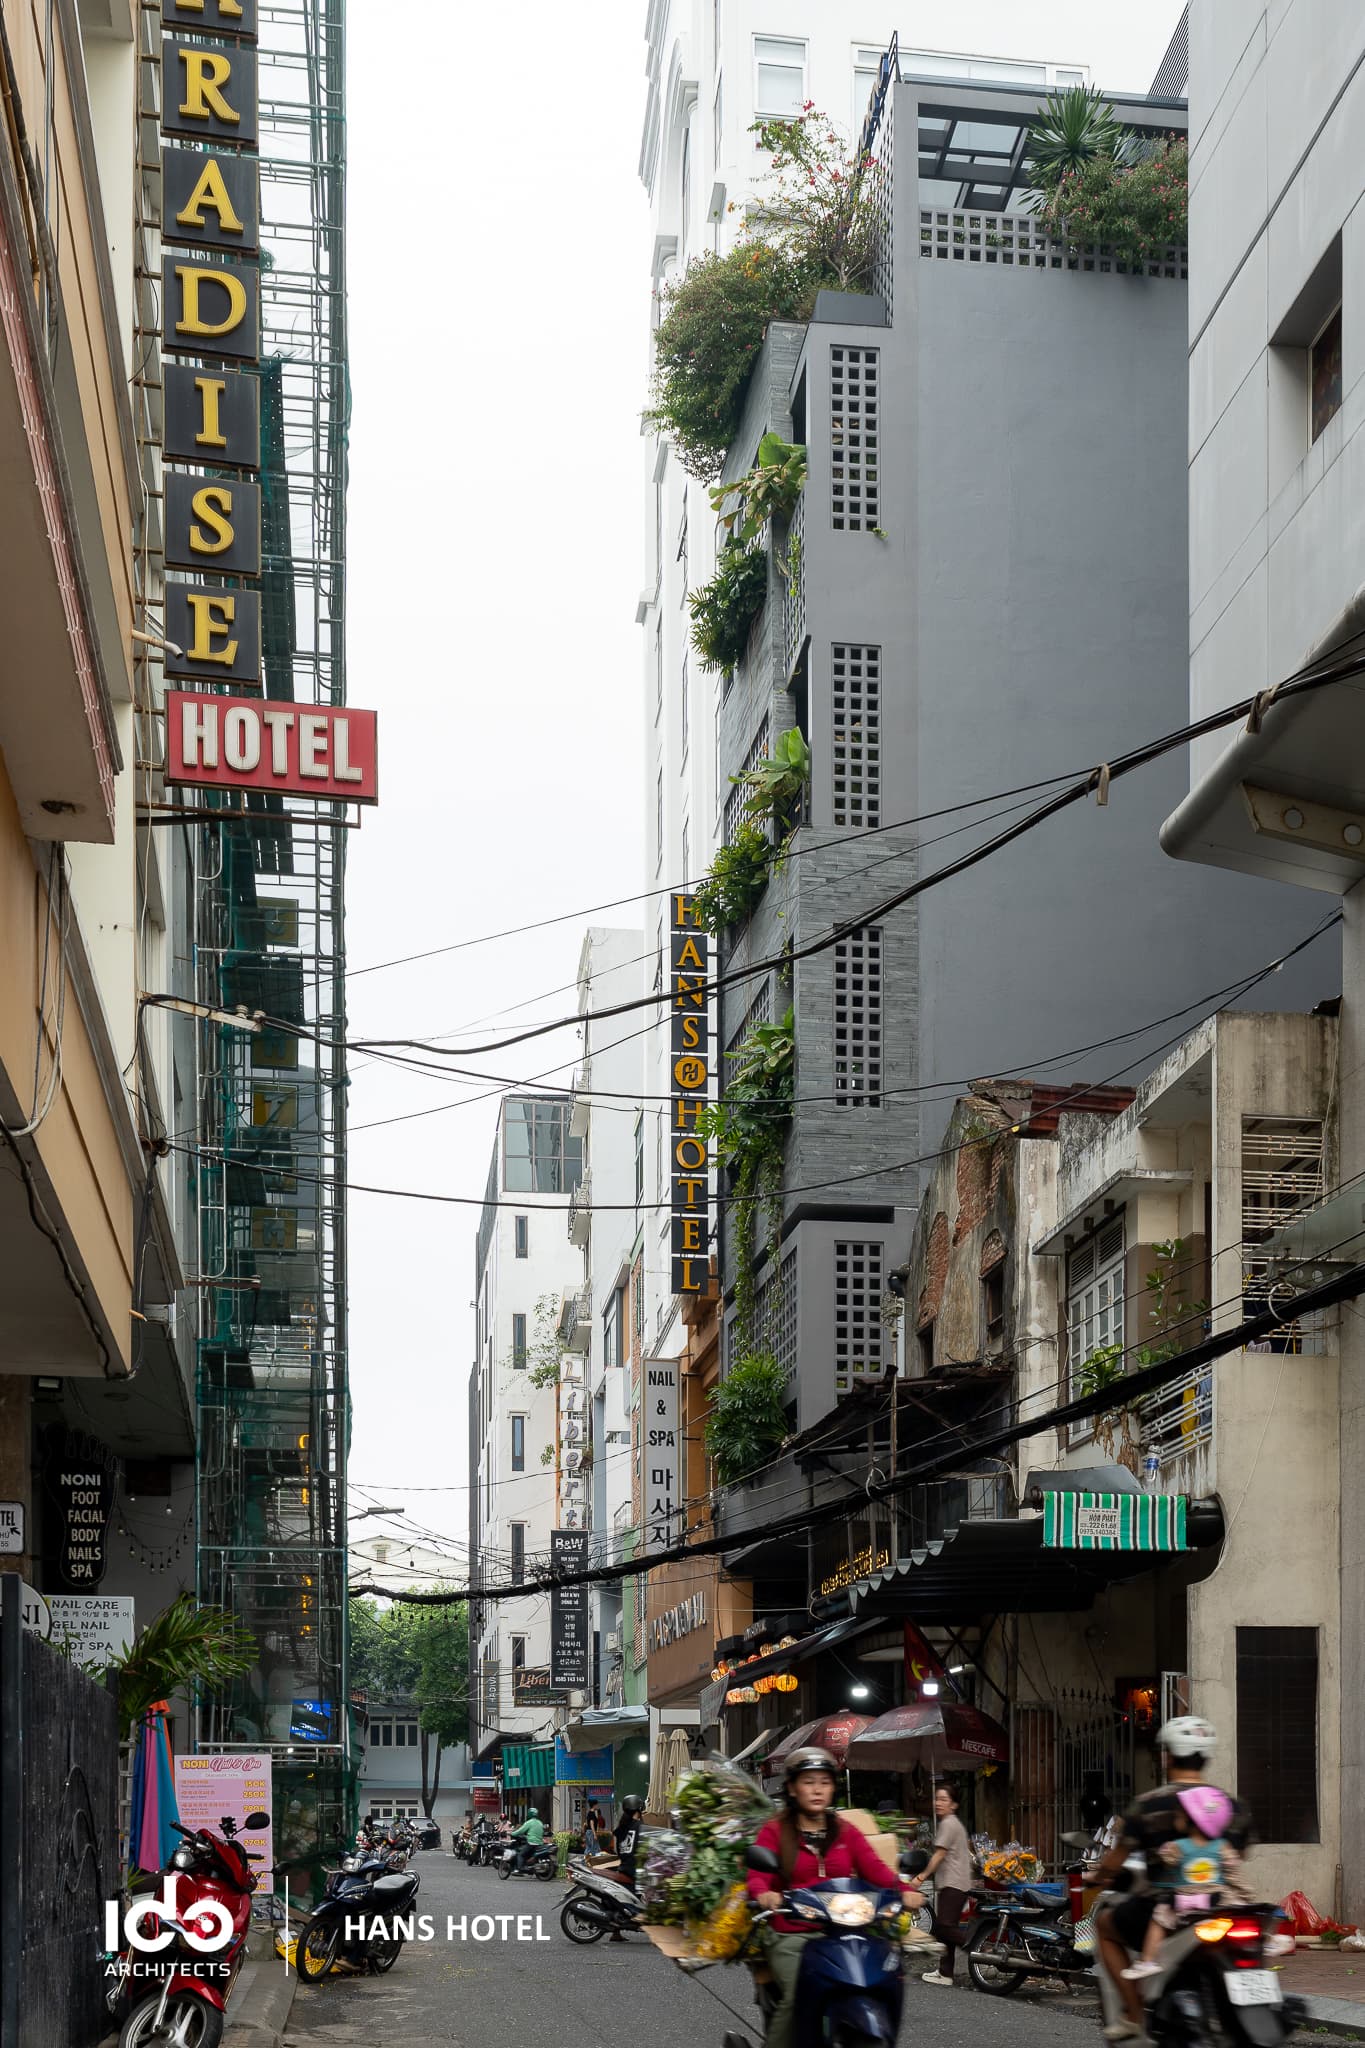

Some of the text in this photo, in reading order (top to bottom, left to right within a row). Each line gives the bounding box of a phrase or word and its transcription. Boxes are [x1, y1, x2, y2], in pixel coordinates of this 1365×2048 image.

[175, 0, 248, 665] RADISE
[181, 702, 363, 783] HOTEL
[675, 1102, 706, 1291] HOTEL
[648, 1371, 675, 1387] NAIL
[656, 1399, 666, 1415] &
[649, 1430, 675, 1447] SPA
[60, 1474, 101, 1486] NONI
[71, 1492, 100, 1505] FOOT
[651, 1468, 674, 1549] 마사지
[67, 1510, 105, 1523] FACIAL
[71, 1529, 100, 1542] BODY
[555, 1538, 583, 1550] B&W
[68, 1547, 101, 1560] NAILS
[71, 1565, 93, 1578] SPA
[51, 1600, 119, 1609] NAIL CARE
[52, 1620, 110, 1630] GEL NAIL
[88, 1642, 113, 1651] SPA
[182, 1760, 209, 1769] NONI
